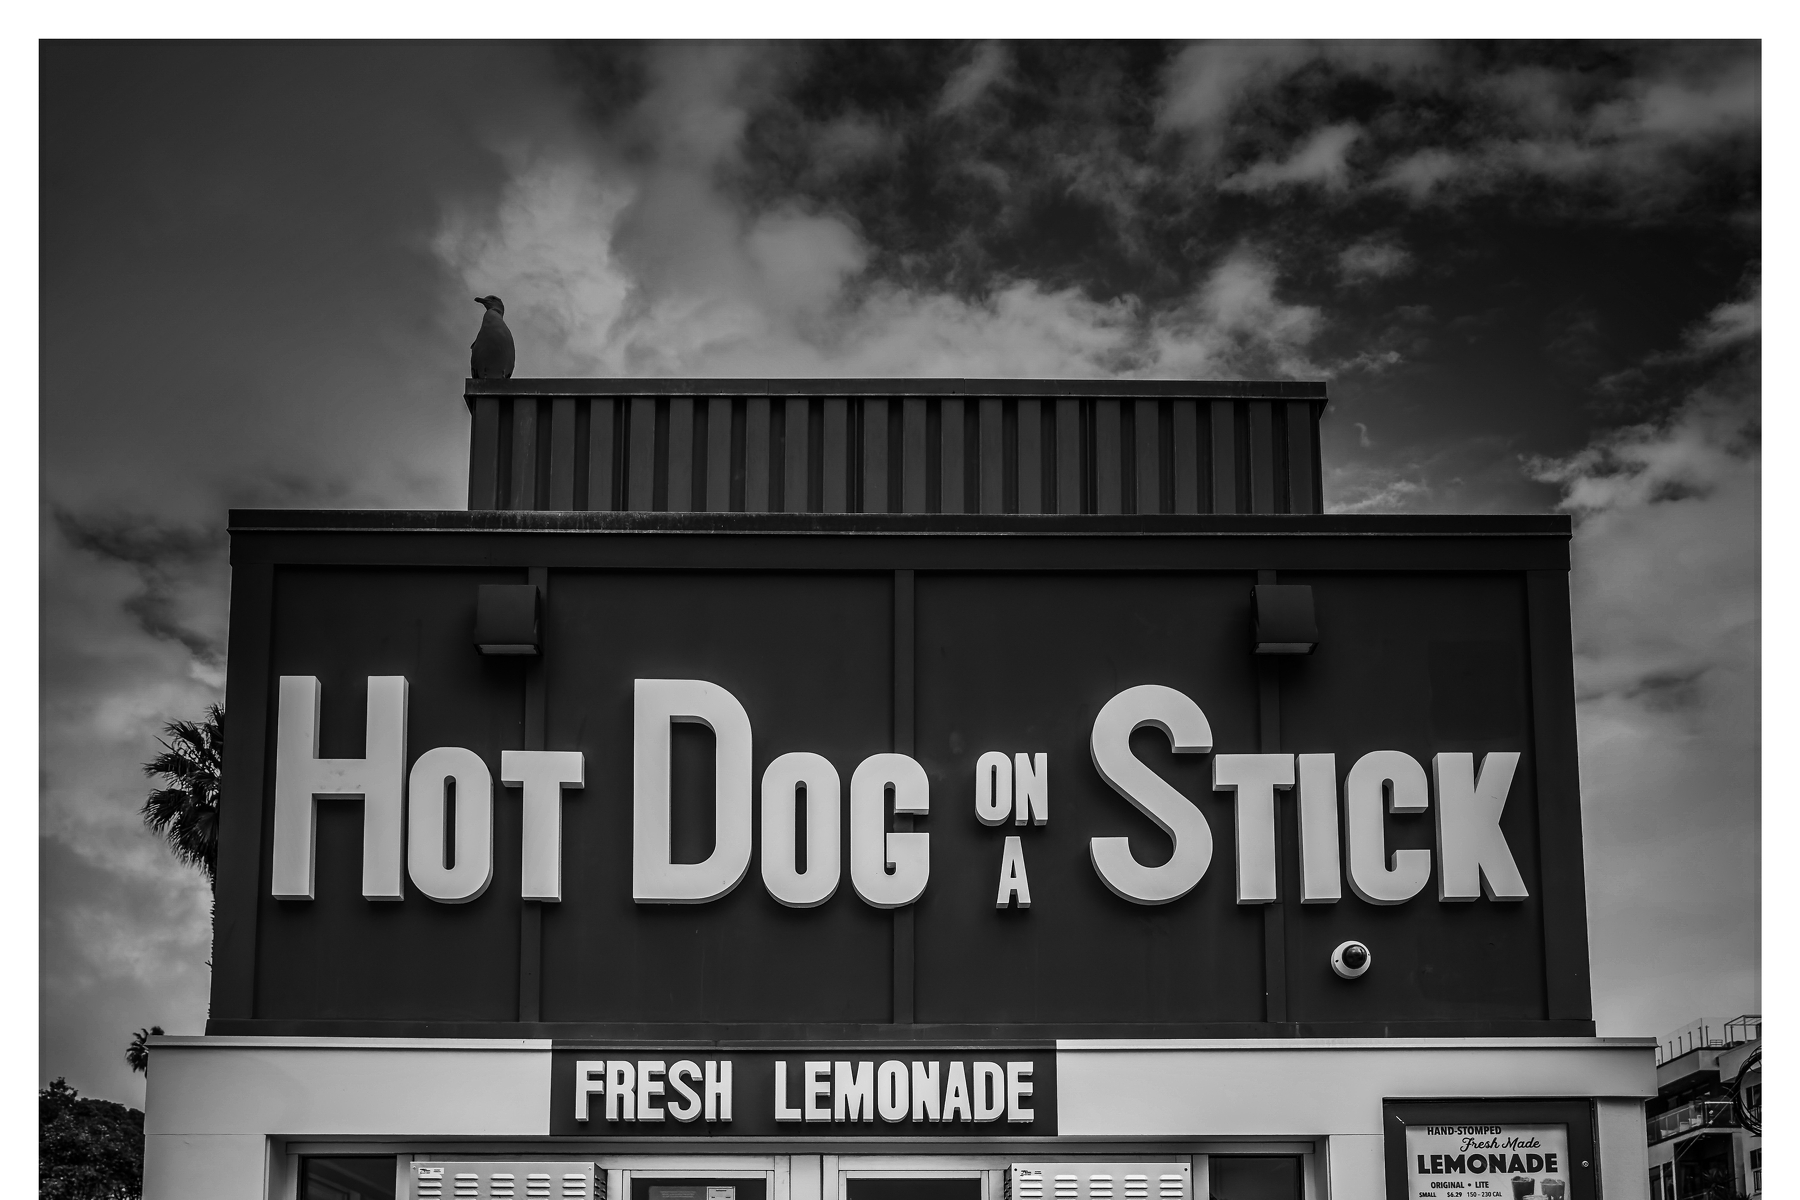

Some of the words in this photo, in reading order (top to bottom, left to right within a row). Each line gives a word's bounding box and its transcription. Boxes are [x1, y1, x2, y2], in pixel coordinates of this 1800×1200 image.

[271, 675, 585, 903] HOT
[631, 678, 931, 906] DOG
[975, 750, 1048, 826] ON
[1090, 684, 1529, 906] STICK
[996, 835, 1032, 910] A
[574, 1059, 733, 1125] FRESH
[773, 1059, 1036, 1125] LEMONADE
[1418, 1153, 1558, 1174] LEMONADE
[1428, 1127, 1501, 1135] HAND-STOMPED
[1460, 1138, 1499, 1152] Fresh
[1502, 1137, 1541, 1150] Made
